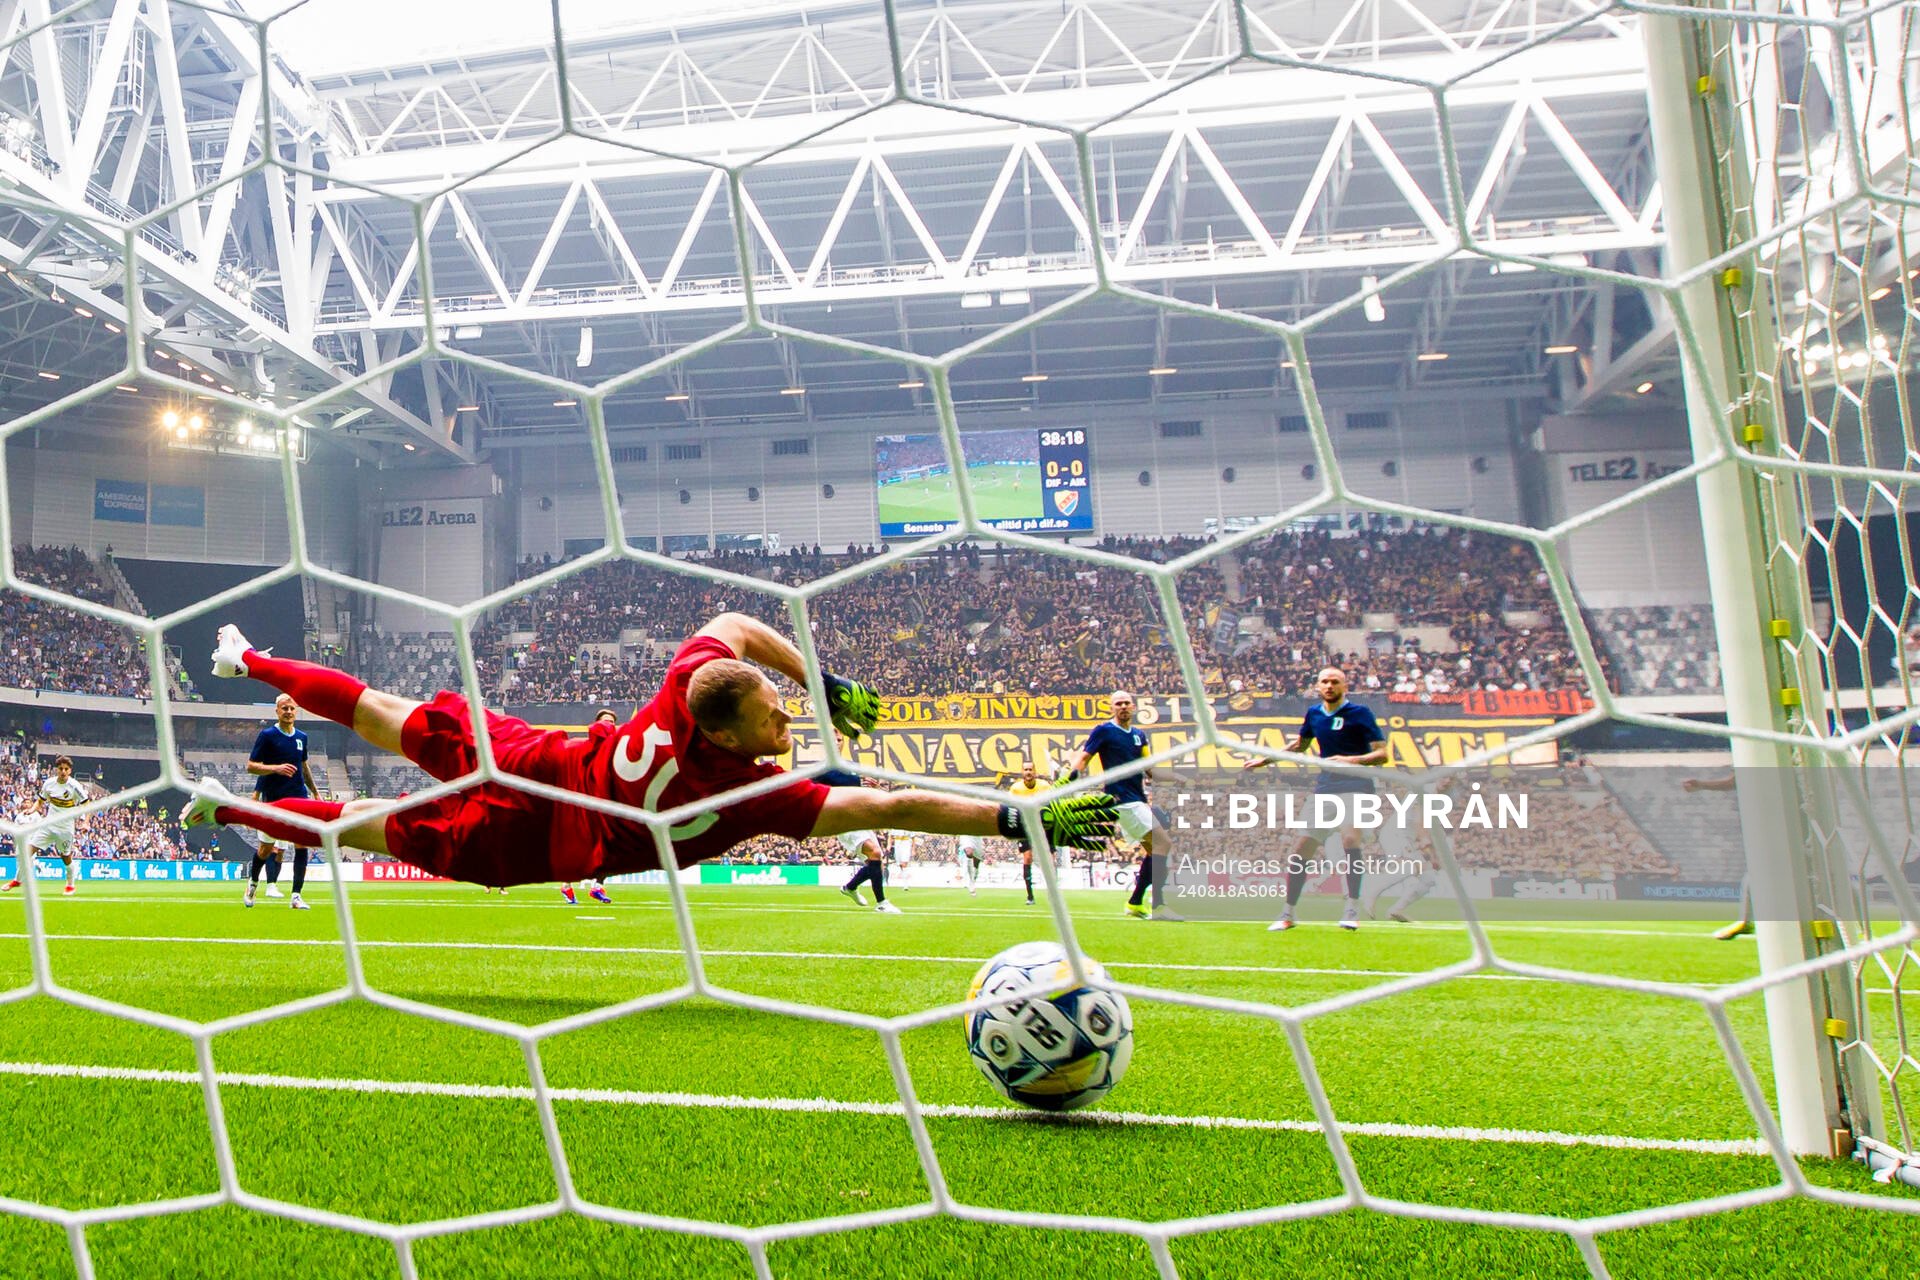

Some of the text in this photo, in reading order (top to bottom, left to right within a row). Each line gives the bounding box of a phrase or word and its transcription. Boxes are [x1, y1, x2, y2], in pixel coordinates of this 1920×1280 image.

[1041, 430, 1085, 446] 38:18
[1046, 461, 1059, 477] 0
[1071, 460, 1083, 476] 0
[1569, 456, 1638, 481] TELE2
[1045, 478, 1061, 488] DIF
[1069, 477, 1087, 487] AIK
[97, 491, 145, 503] AMERICAN
[103, 500, 145, 511] EXPRESS
[382, 506, 477, 527] ELE2 Arena
[903, 523, 944, 533] Senaste
[1023, 518, 1037, 532] på
[1039, 518, 1069, 529] dif.se
[878, 694, 1115, 721] SOL INVICTUS
[1330, 717, 1344, 731] D
[838, 732, 1105, 775] GNAGE
[373, 865, 443, 879] BAUH
[1513, 878, 1616, 900] stadium
[989, 979, 1066, 1051] SELET
